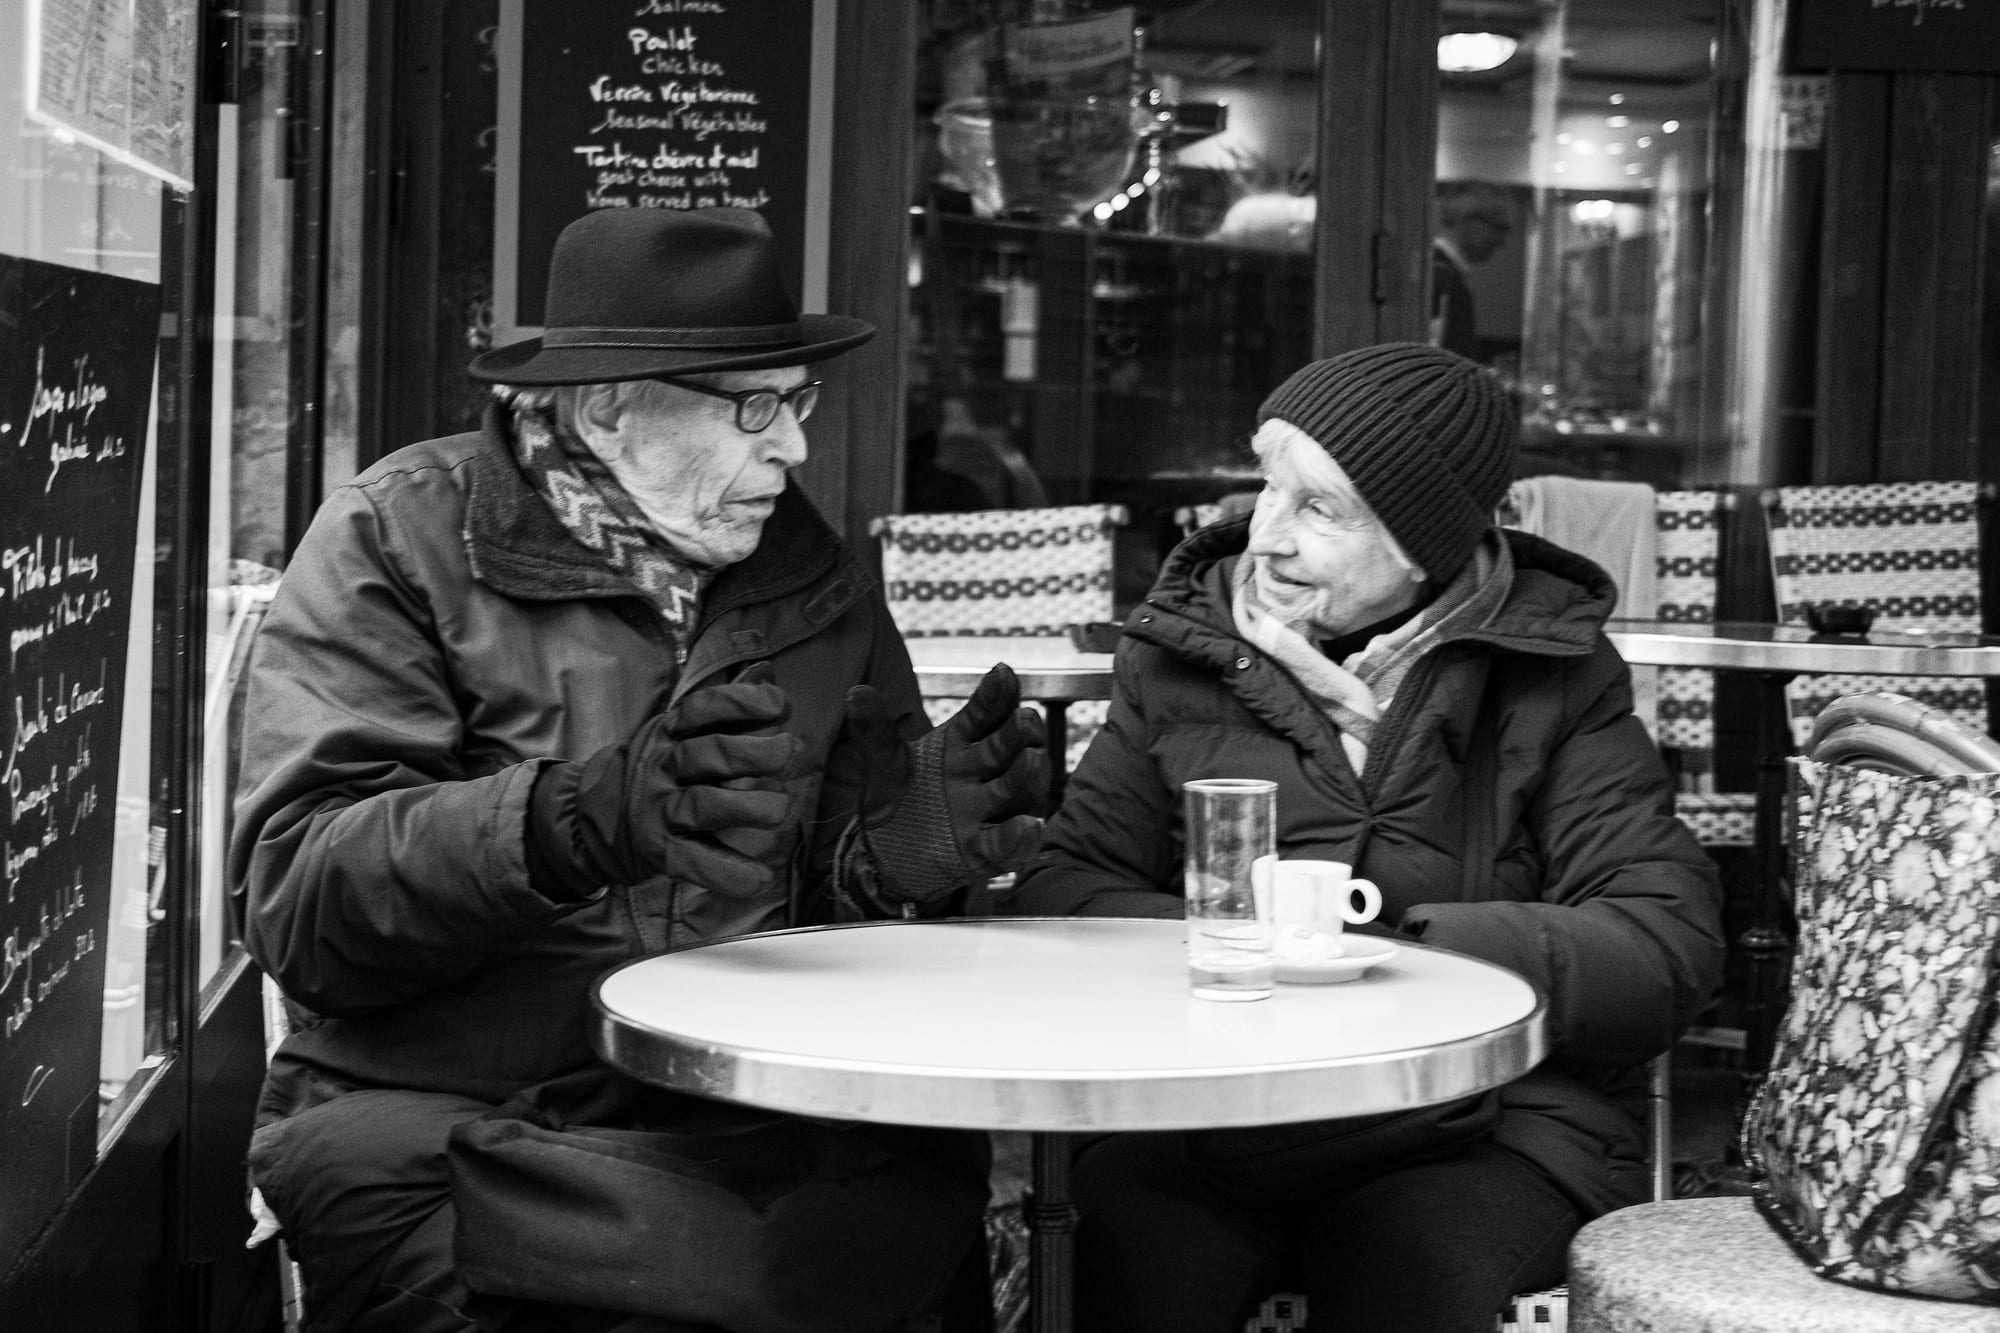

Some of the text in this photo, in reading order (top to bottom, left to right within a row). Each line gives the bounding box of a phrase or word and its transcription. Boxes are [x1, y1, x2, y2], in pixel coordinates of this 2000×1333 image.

[628, 26, 697, 55] Poulet
[641, 53, 725, 76] Chicken
[708, 143, 727, 169] et
[694, 168, 730, 188] with
